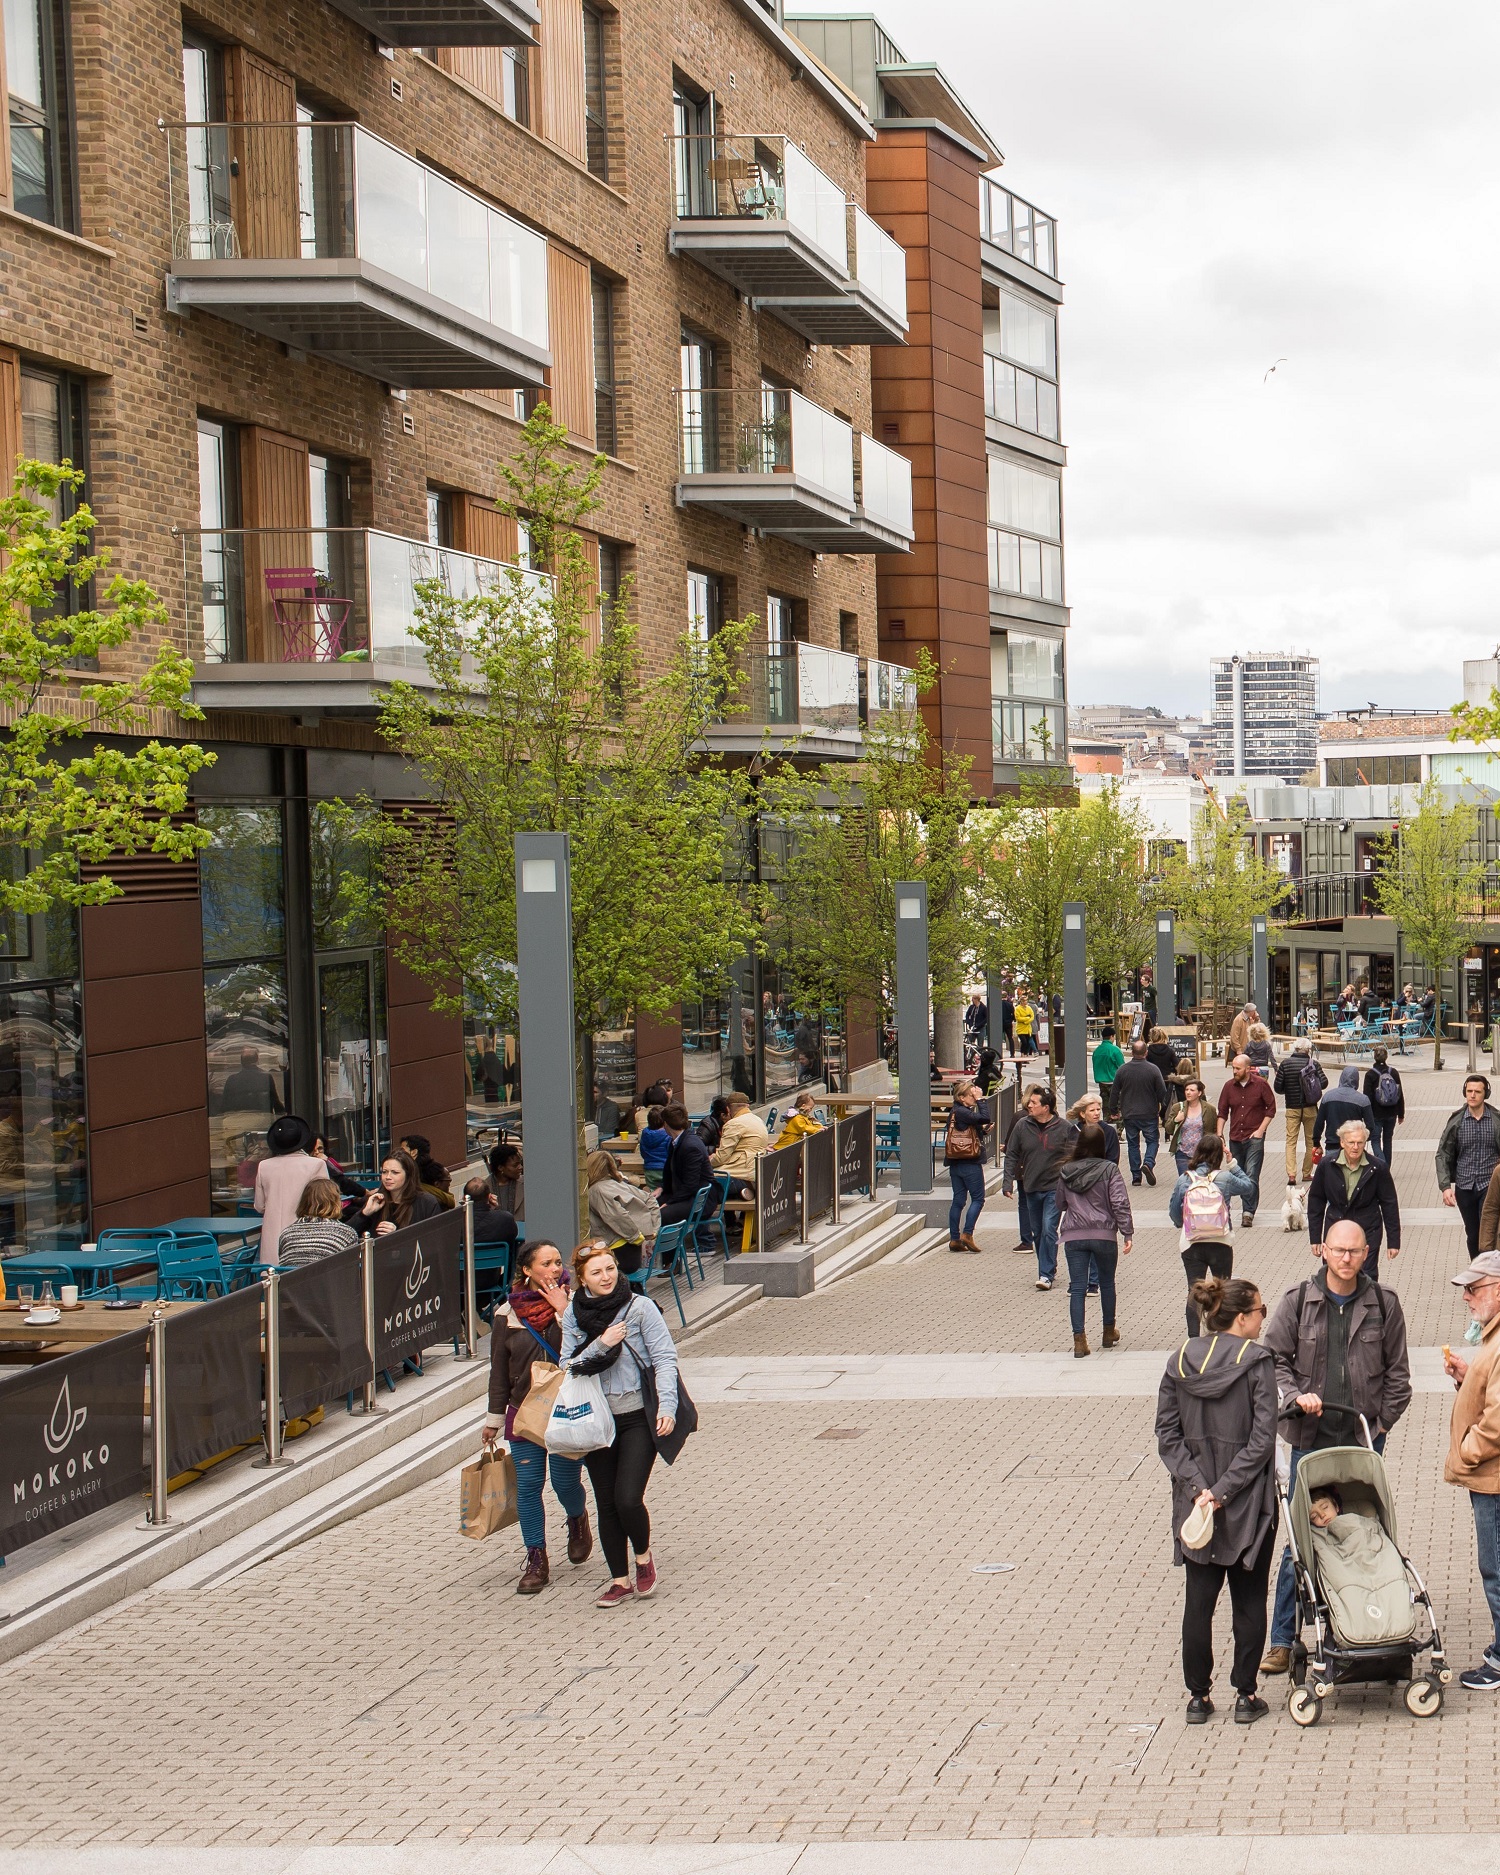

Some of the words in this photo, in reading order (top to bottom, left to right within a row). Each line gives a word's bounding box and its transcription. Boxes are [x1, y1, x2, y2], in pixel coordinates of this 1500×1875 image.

[840, 1160, 861, 1175] OKOKO
[384, 1295, 441, 1333] MOKOKO
[391, 1331, 410, 1348] COFFEE
[412, 1329, 417, 1338] &
[418, 1321, 438, 1336] BAKERY
[13, 1444, 110, 1504] MOKOKO
[25, 1496, 58, 1522] COFFEE
[61, 1493, 67, 1504] &
[70, 1478, 102, 1501] BAKERY
